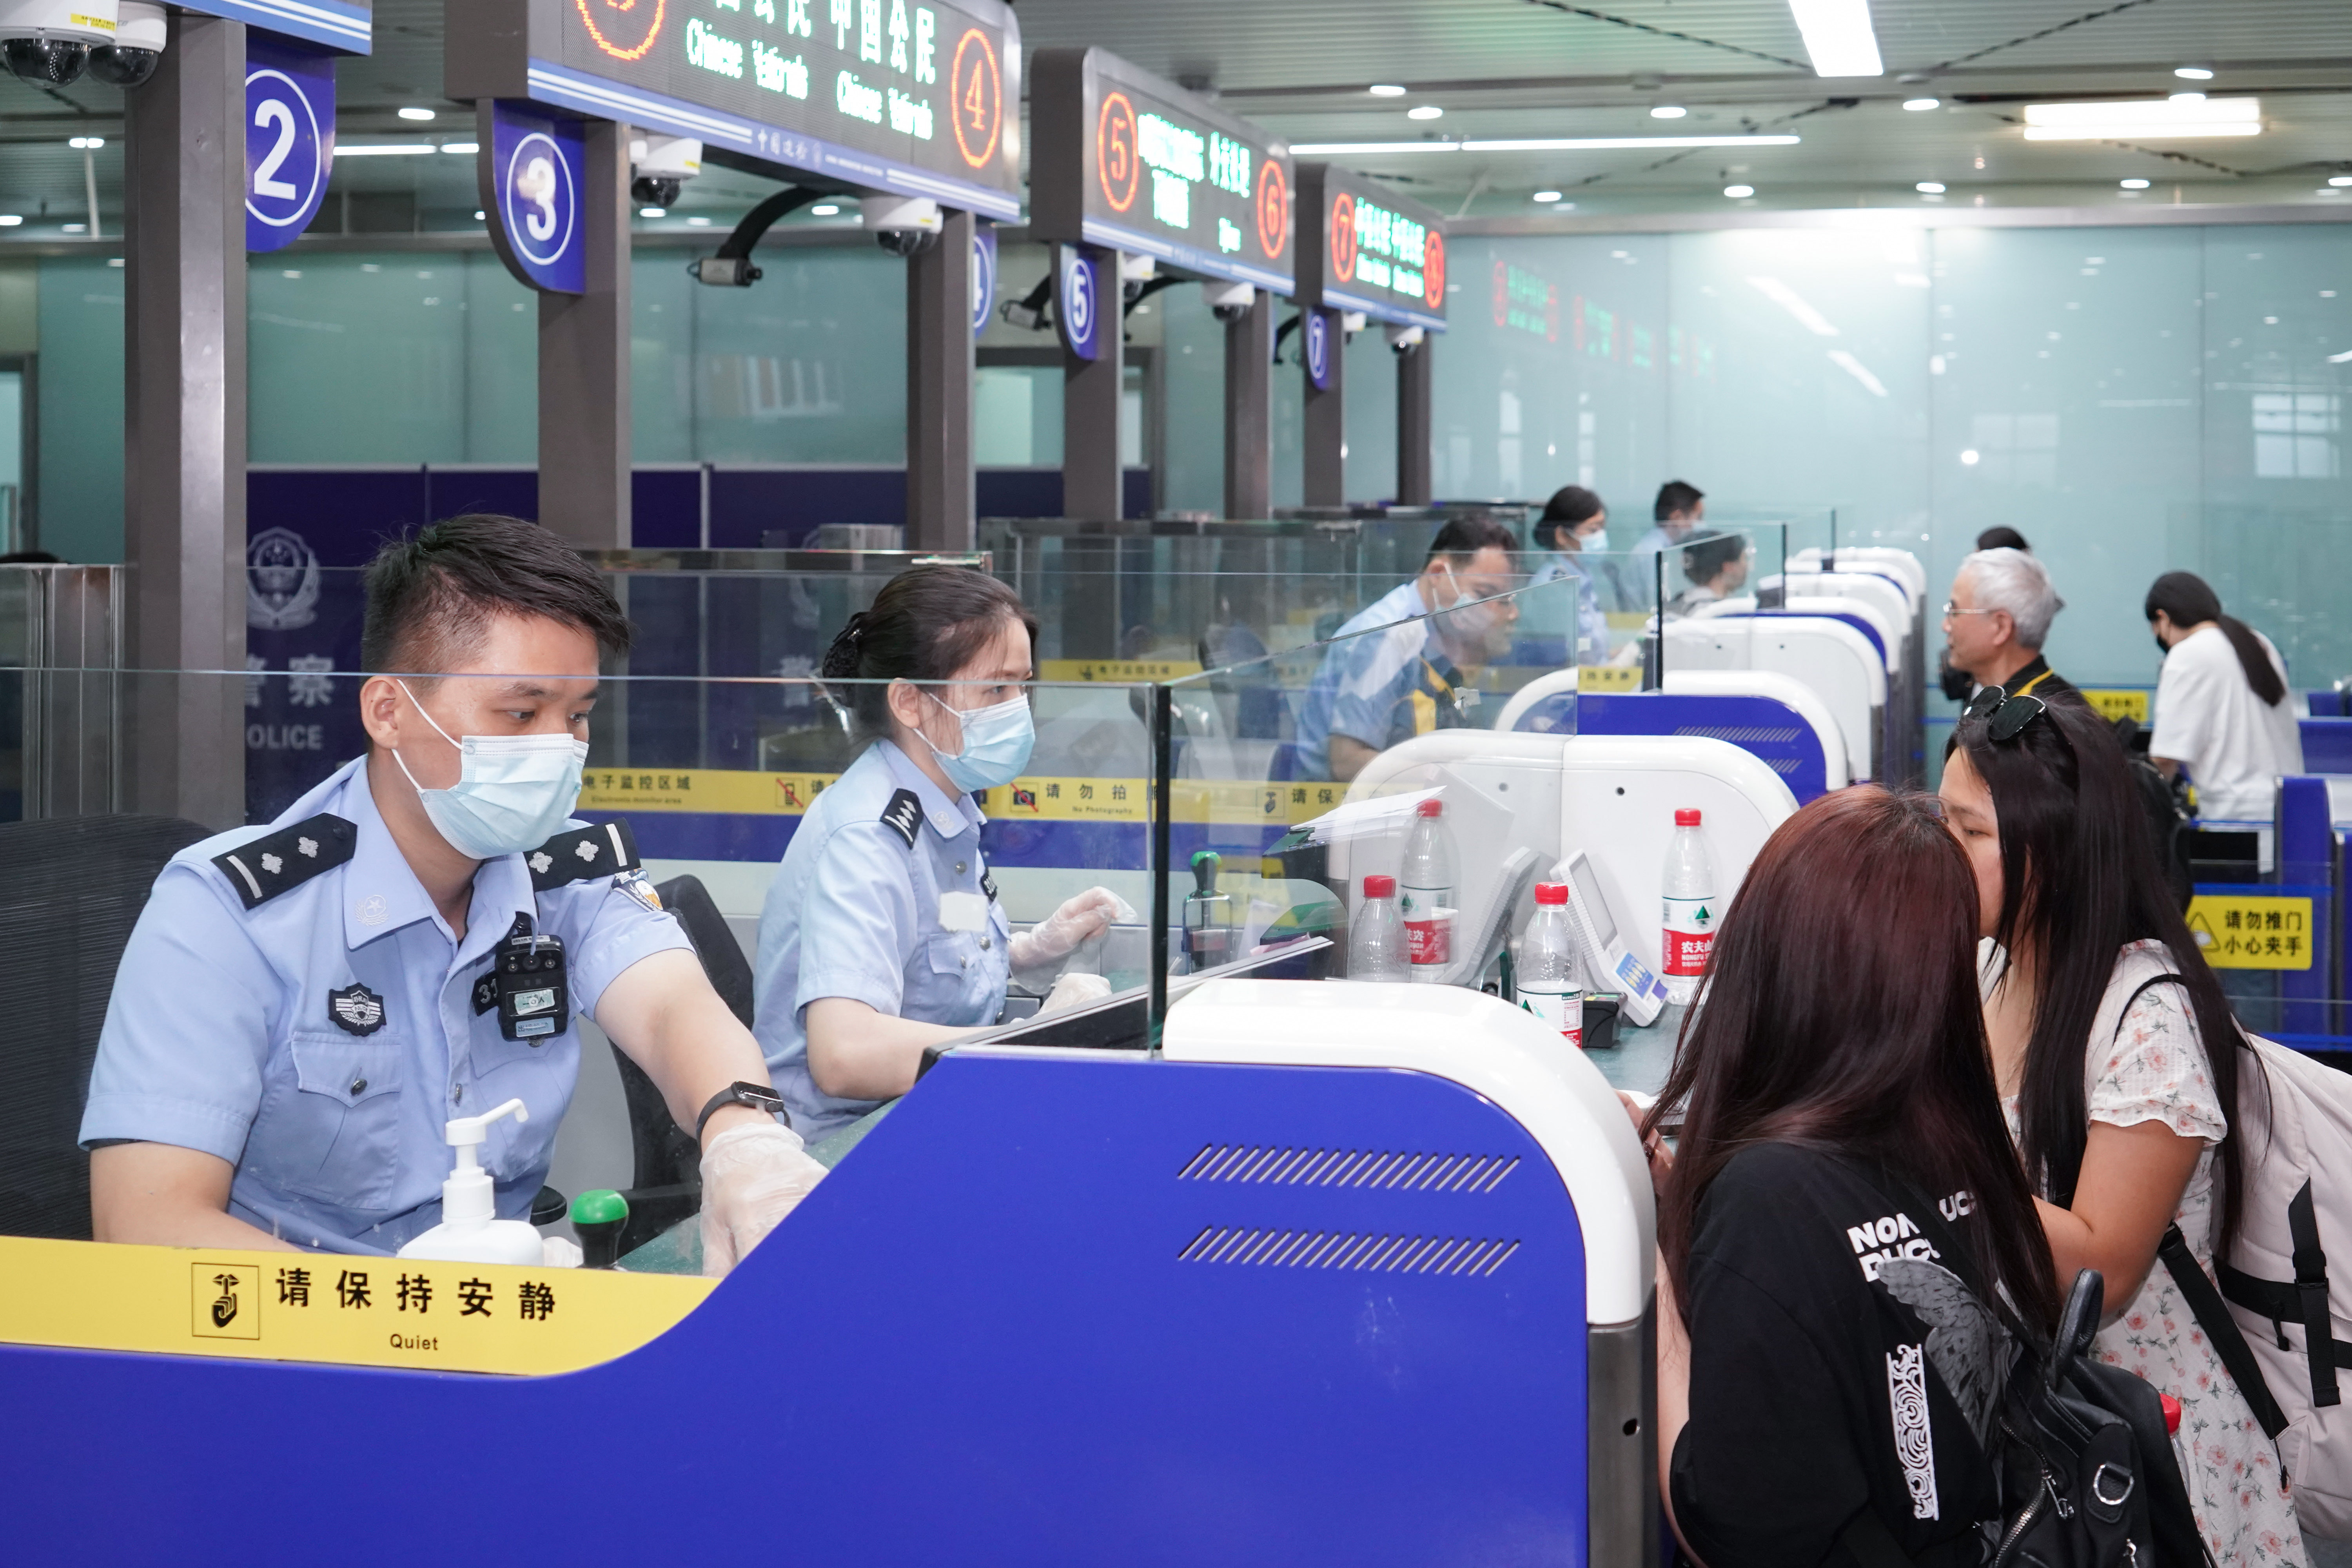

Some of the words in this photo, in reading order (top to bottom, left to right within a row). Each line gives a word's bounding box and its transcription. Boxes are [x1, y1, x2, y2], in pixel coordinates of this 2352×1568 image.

[965, 59, 986, 131] 4
[254, 98, 296, 201] 2
[1111, 116, 1127, 181] 5
[525, 156, 557, 242] 3
[1267, 184, 1279, 236] 6
[1339, 214, 1350, 262] 7
[1073, 274, 1088, 328] 5
[1314, 328, 1323, 367] 7
[247, 724, 323, 750] OLICE
[2224, 935, 2303, 956] 小心夹手
[2225, 910, 2303, 931] 请勿推门
[275, 1267, 555, 1321] 请保持安静
[389, 1334, 438, 1351] Quiet
